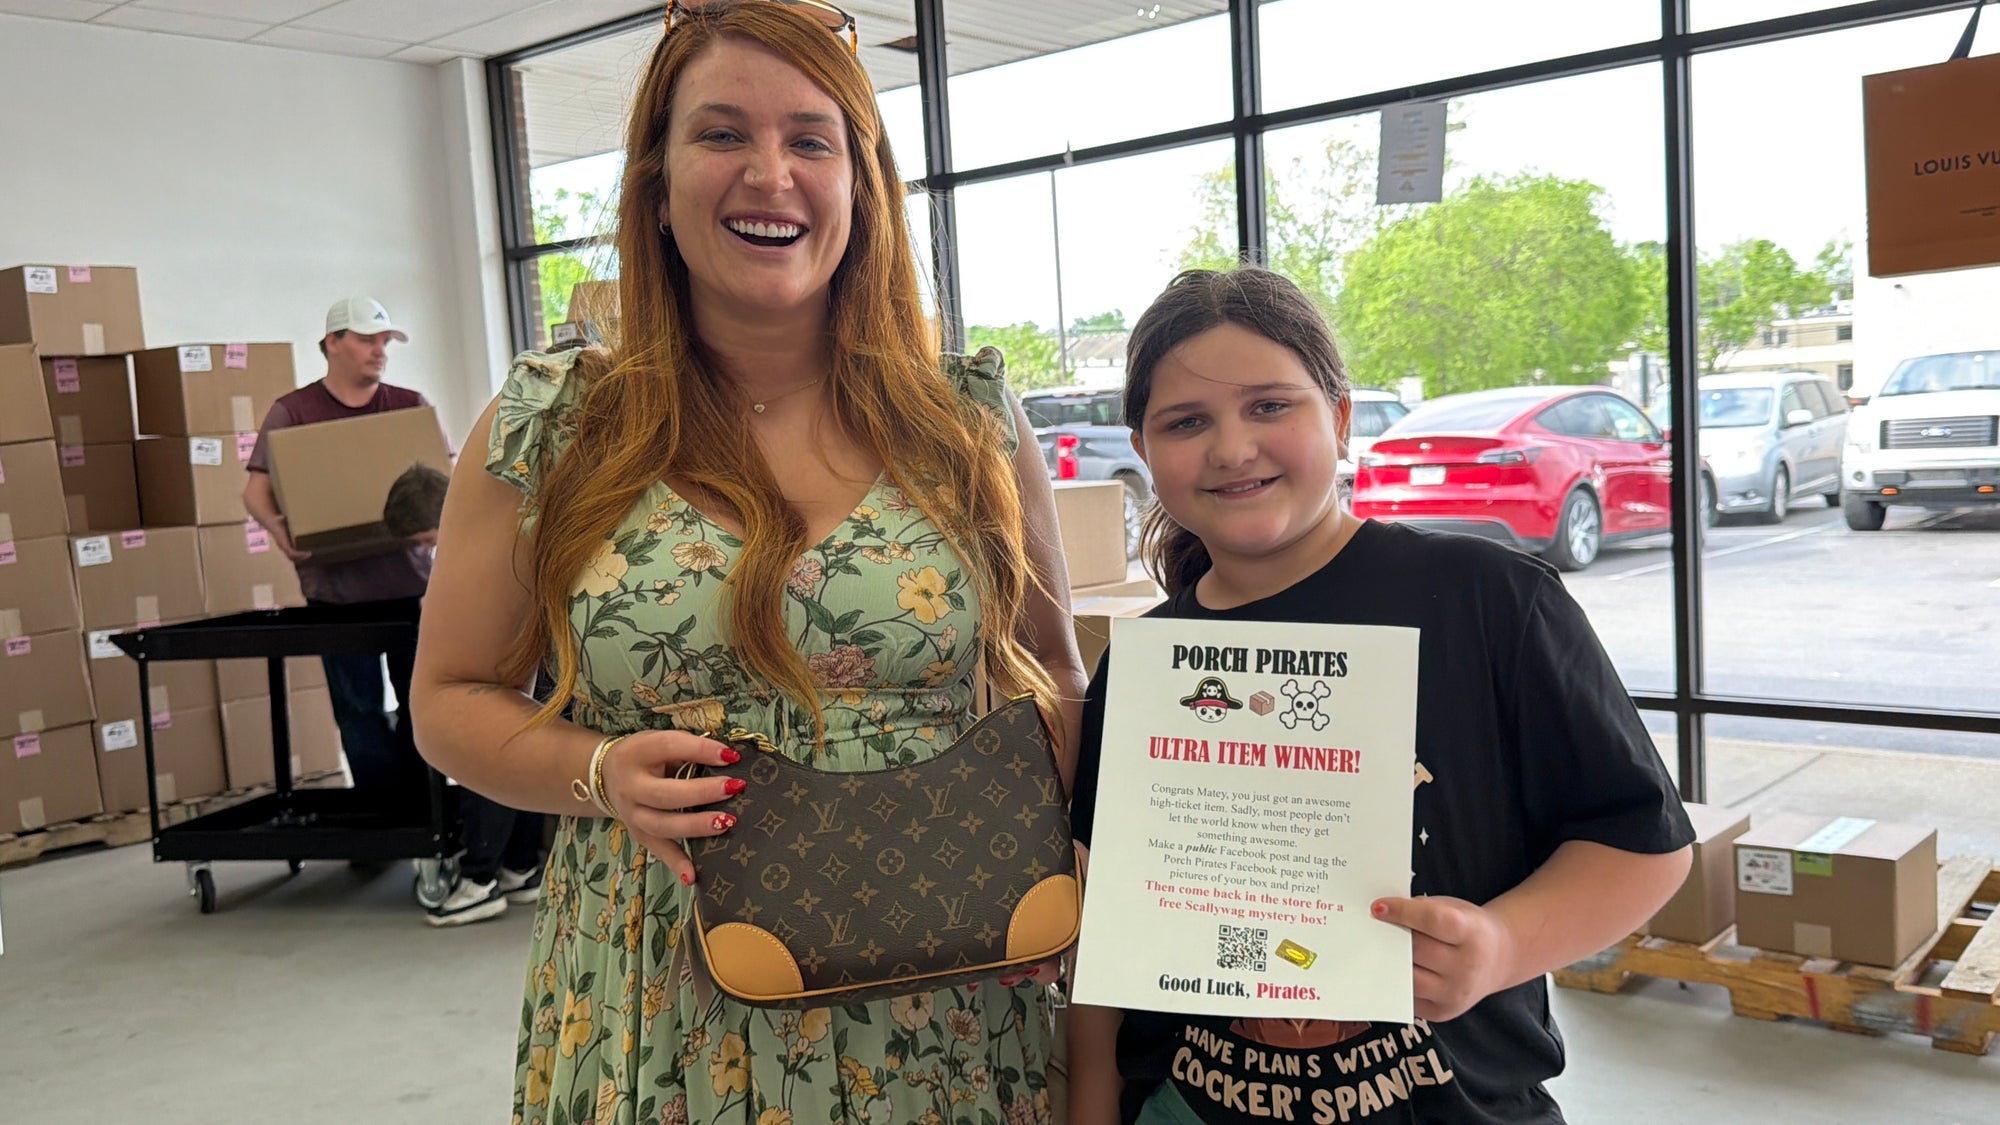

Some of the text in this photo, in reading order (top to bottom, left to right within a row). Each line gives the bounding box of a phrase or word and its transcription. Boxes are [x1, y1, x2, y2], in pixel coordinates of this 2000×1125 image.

[1914, 154, 1971, 176] LOUIS
[1172, 644, 1348, 678] PORCH PIRATES
[1149, 736, 1361, 774] ULTRA ITEM WINNER!
[1150, 797, 1201, 810] high-ticket
[1204, 801, 1228, 813] item.
[1231, 804, 1260, 818] Sadly,
[1263, 808, 1287, 818] most
[1289, 810, 1323, 822] people
[1151, 782, 1351, 809] Congrats Matey, you just got an awesome
[1168, 812, 1329, 838] let the world know when they get
[1148, 838, 1347, 868] Make a public Facebook post and tag the
[1197, 831, 1298, 848] something awesome.
[1163, 853, 1329, 881] Porch Pirates Facebook page with
[1169, 868, 1320, 894] pictures of your box and prize!
[1145, 880, 1344, 912] Then come back in the store for a
[1159, 897, 1327, 926] free Scallywag mystery box!
[1159, 974, 1321, 1001] Good Luck, Pirates.
[1185, 1024, 1235, 1065] HAVE
[1333, 1032, 1398, 1075] WITH
[1400, 1018, 1432, 1050] MY
[1311, 1048, 1454, 1125] SPANIEL
